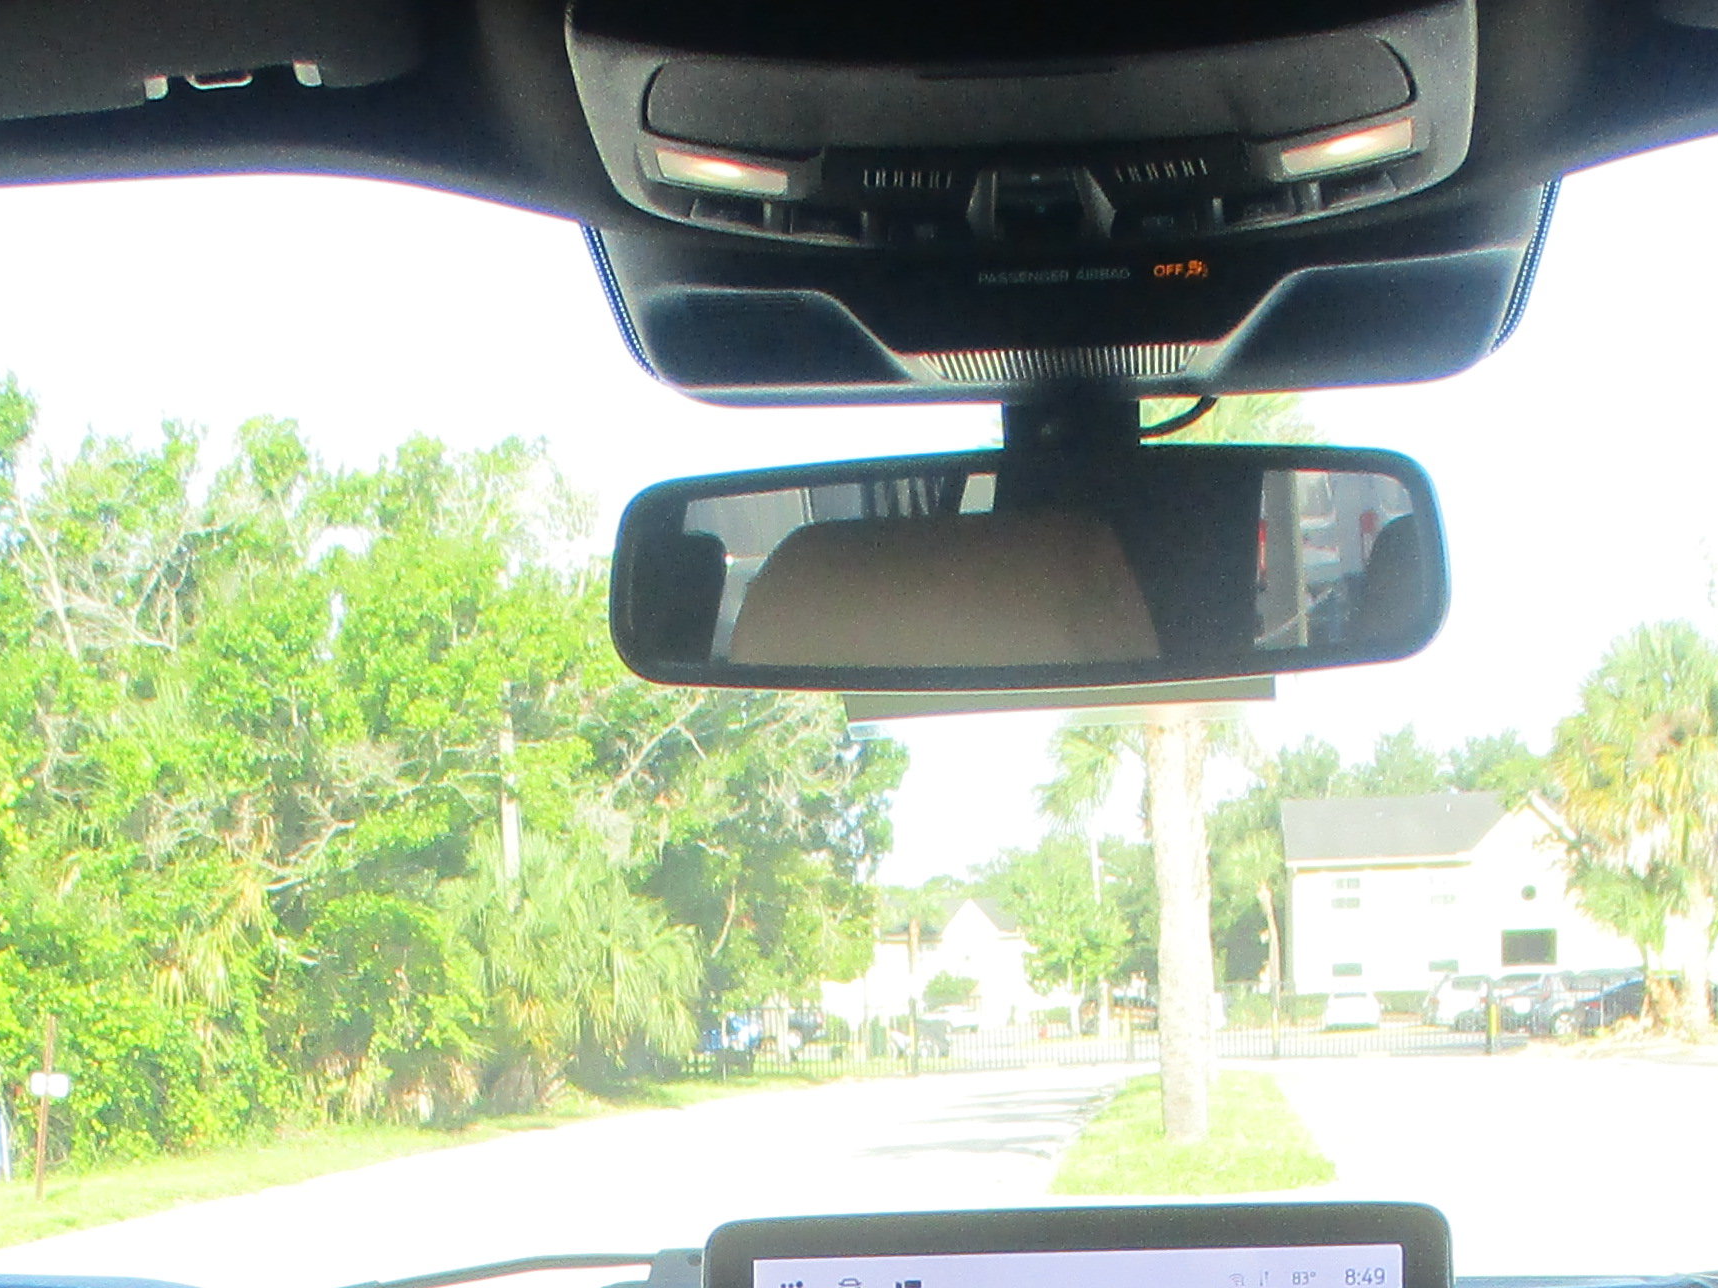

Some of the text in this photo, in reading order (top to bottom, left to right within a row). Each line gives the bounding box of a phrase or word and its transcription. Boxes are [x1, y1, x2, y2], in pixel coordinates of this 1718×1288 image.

[978, 263, 1184, 284] PASSENGER AIRBAG OFF
[1344, 1267, 1386, 1286] 8:49
